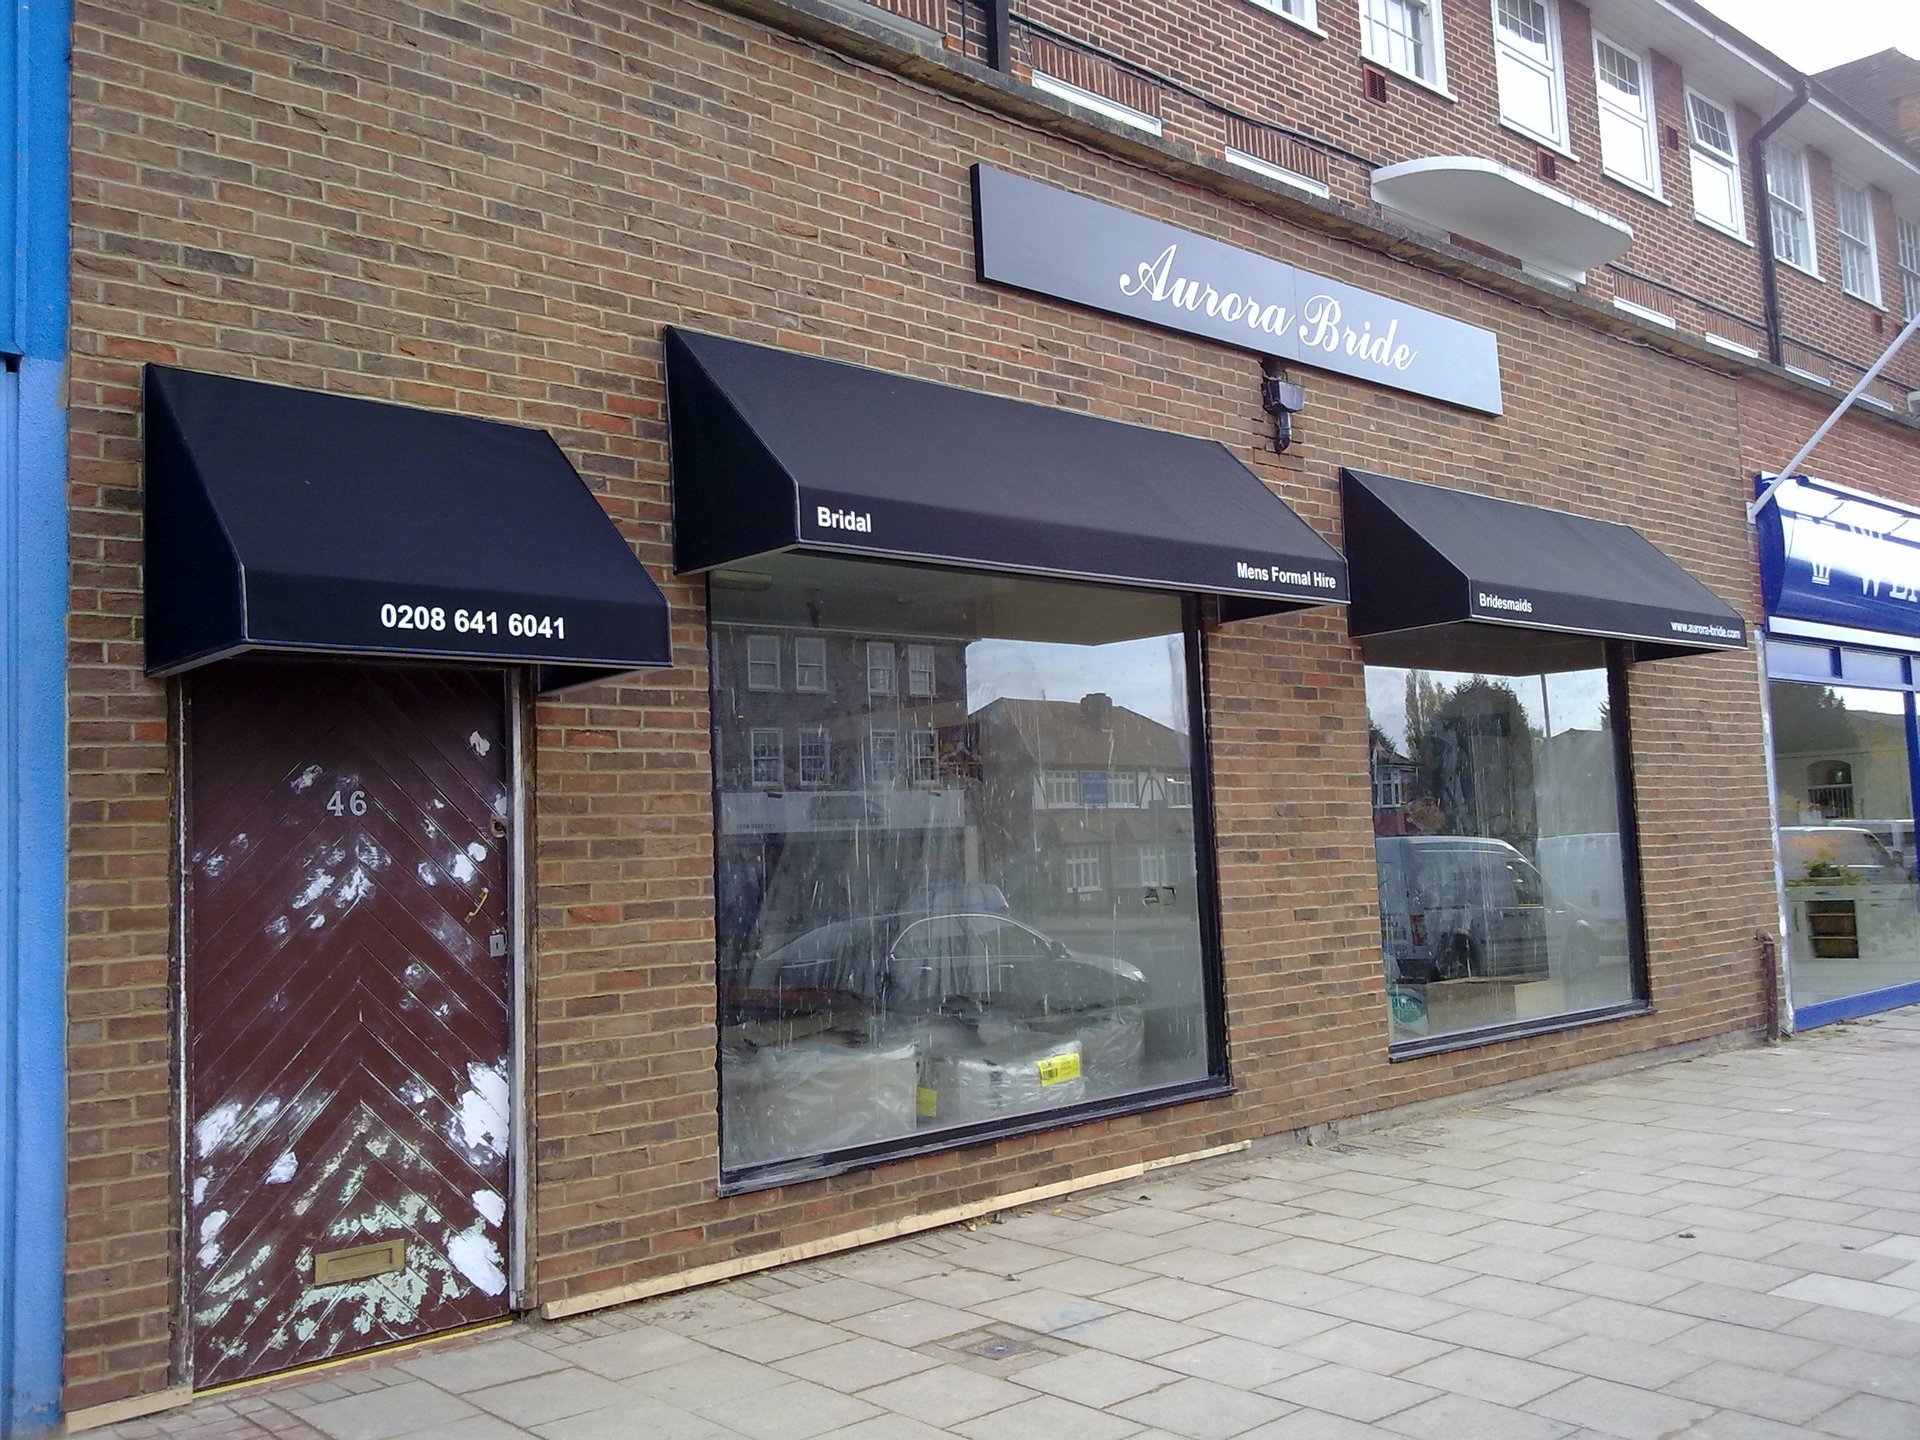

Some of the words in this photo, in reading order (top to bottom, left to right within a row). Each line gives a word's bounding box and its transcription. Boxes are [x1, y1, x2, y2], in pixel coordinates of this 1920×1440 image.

[1119, 244, 1297, 337] Aurora
[1299, 294, 1418, 371] Bride
[817, 506, 872, 532] Bridal
[1236, 561, 1269, 582] Mens
[1271, 566, 1311, 586] Formal
[1313, 571, 1336, 589] Hire
[1479, 592, 1532, 613] Bridesmaids
[380, 603, 446, 631] 0208
[453, 609, 498, 635] 641
[508, 613, 565, 640] 6041
[326, 790, 368, 817] 46
